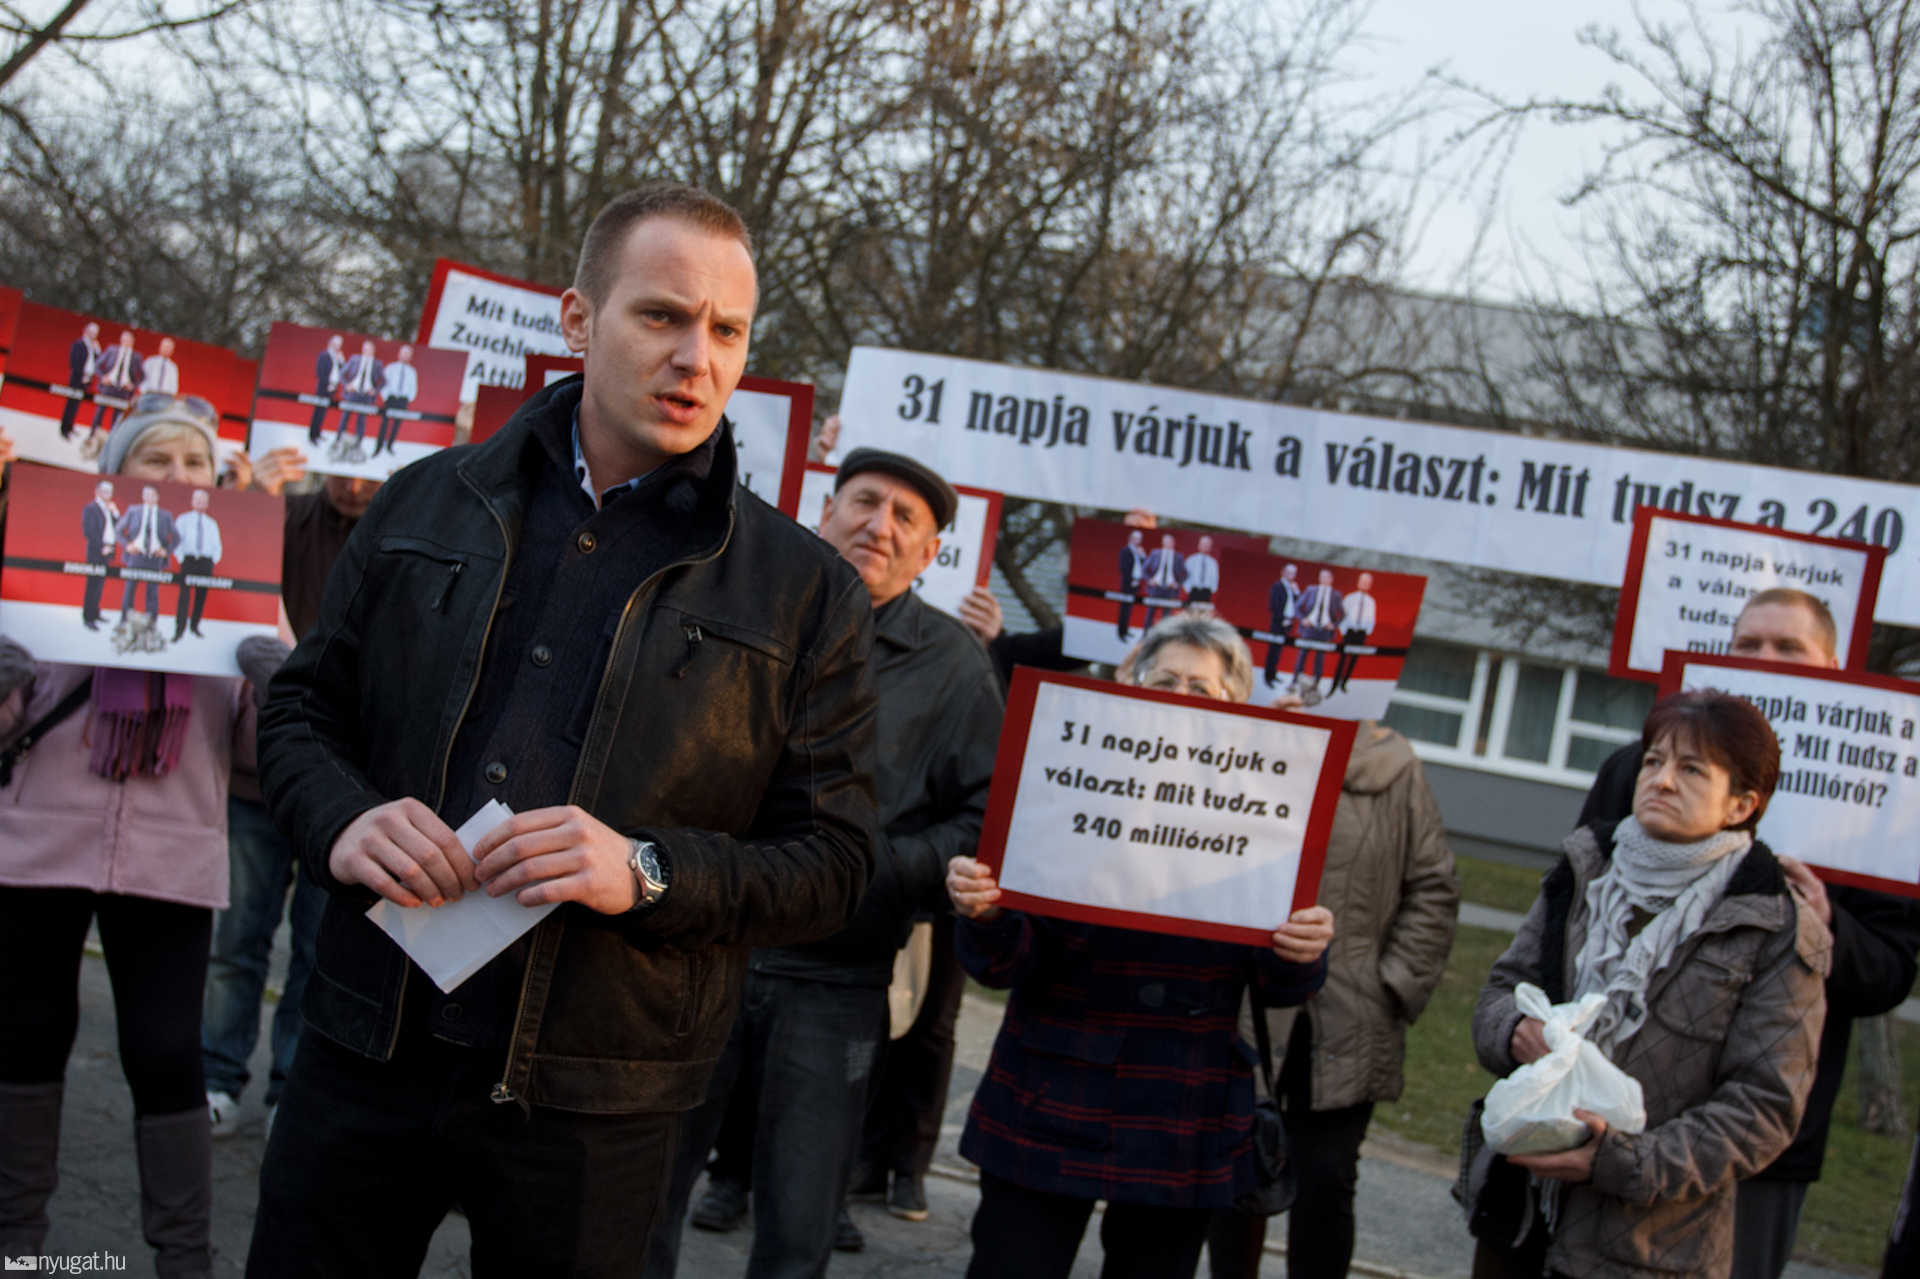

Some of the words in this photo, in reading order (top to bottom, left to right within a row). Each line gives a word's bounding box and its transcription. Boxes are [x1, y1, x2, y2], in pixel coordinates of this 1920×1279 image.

[467, 294, 505, 322] Mit
[450, 321, 545, 358] Zuschl
[898, 374, 945, 424] 31
[965, 389, 1090, 449] napja
[1111, 404, 1252, 471] várjuk
[1275, 434, 1303, 478] a
[1324, 435, 1500, 507] választ:
[1514, 460, 1592, 519] Mit
[1757, 499, 1787, 530] a
[1807, 498, 1904, 557] 240
[1665, 540, 1691, 560] 31
[1701, 549, 1765, 573] napja
[1773, 561, 1843, 586] várjuk
[1668, 575, 1681, 589] a
[1678, 605, 1737, 626] tuds
[1745, 695, 1807, 723] apja
[1817, 701, 1894, 737] várjuk
[1901, 718, 1914, 740] a
[1061, 721, 1091, 746] 31
[1102, 733, 1178, 763] napja
[1187, 742, 1265, 774] várjuk
[1272, 758, 1287, 776] a
[1793, 733, 1830, 762] Mit
[1837, 741, 1897, 773] tudsz
[1904, 755, 1918, 778] a
[1045, 766, 1146, 799] választ:
[1154, 781, 1195, 806] Mit
[1203, 788, 1268, 817] tudsz
[1275, 802, 1290, 819] a
[1073, 813, 1121, 839] 240
[1129, 824, 1249, 856] millióról?
